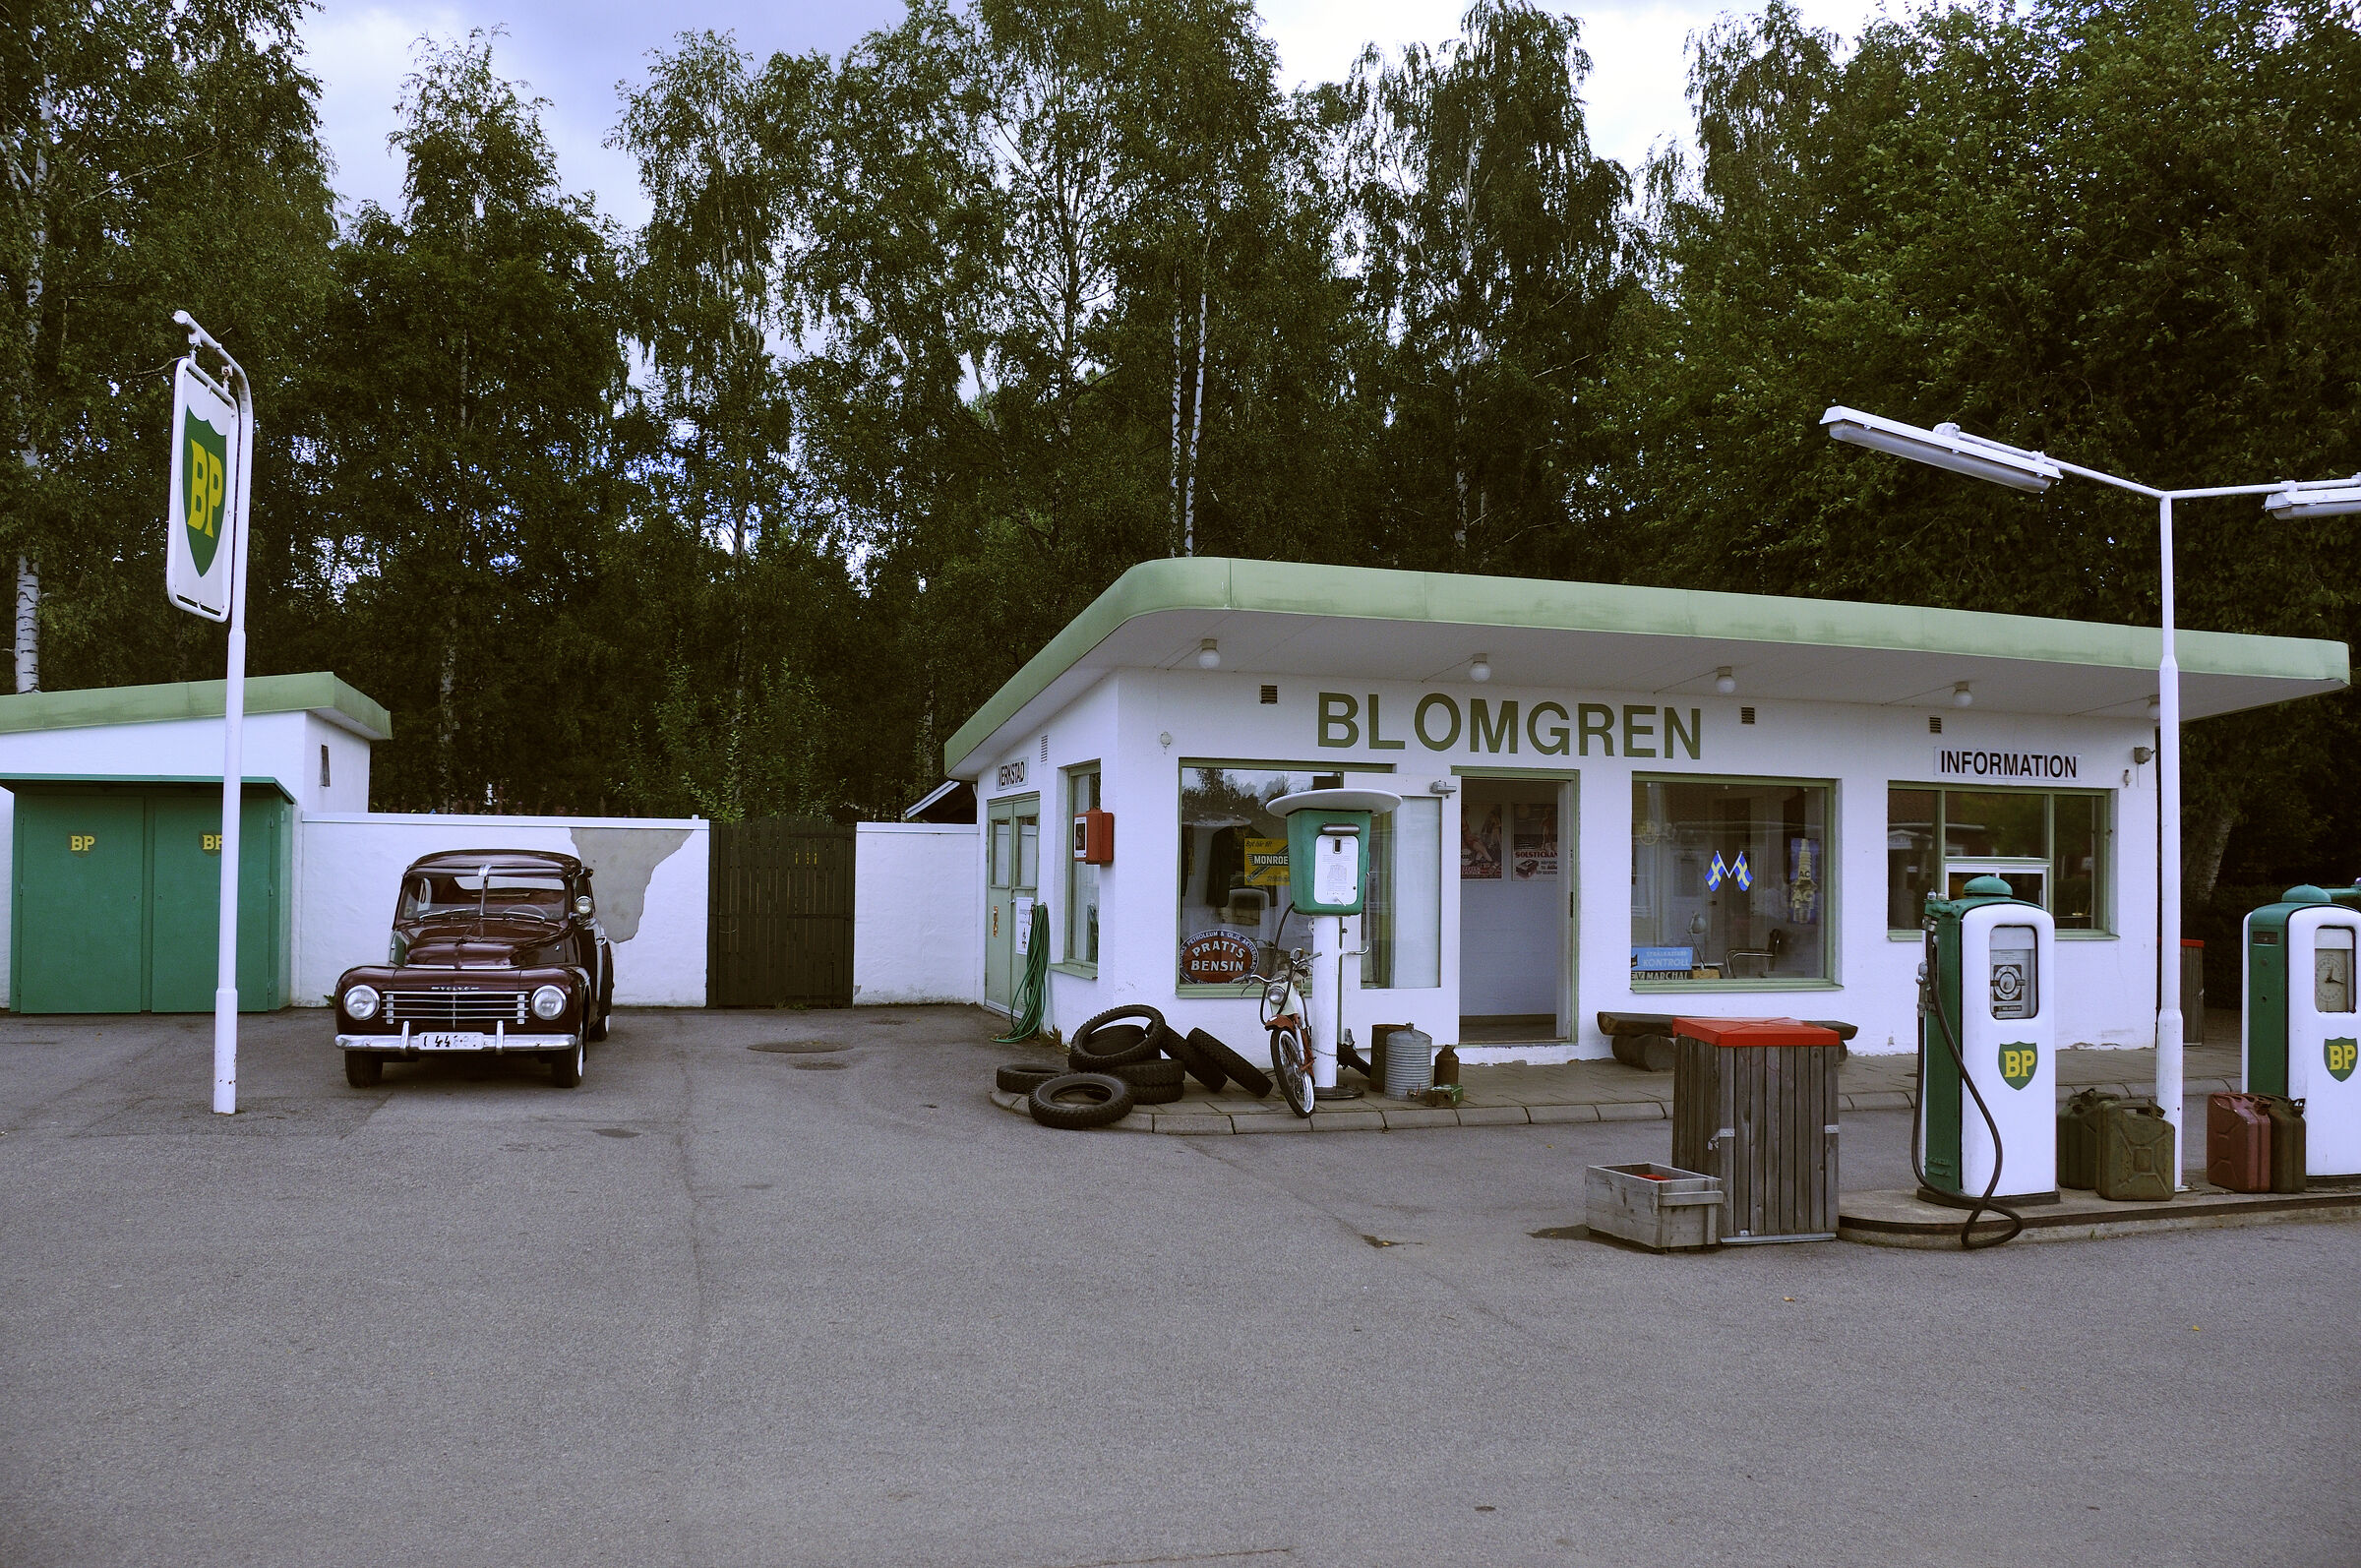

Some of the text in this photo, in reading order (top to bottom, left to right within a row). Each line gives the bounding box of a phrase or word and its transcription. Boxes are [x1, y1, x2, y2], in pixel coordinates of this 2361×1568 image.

[186, 438, 223, 539] BP
[1317, 692, 1701, 760] BLOMGREN
[998, 761, 1024, 787] VERKSTAD
[1941, 751, 2077, 778] INFORMATION
[71, 835, 95, 851] BP
[1253, 855, 1289, 865] MONROE
[1186, 931, 1218, 945] PETROLEUM
[1191, 940, 1245, 959] PRATTS
[1190, 959, 1244, 972] BENSIN
[1643, 958, 1689, 967] KONTROLL
[1646, 971, 1688, 981] MARCHAL
[2004, 1050, 2035, 1078] BP
[2328, 1045, 2356, 1070] BP
